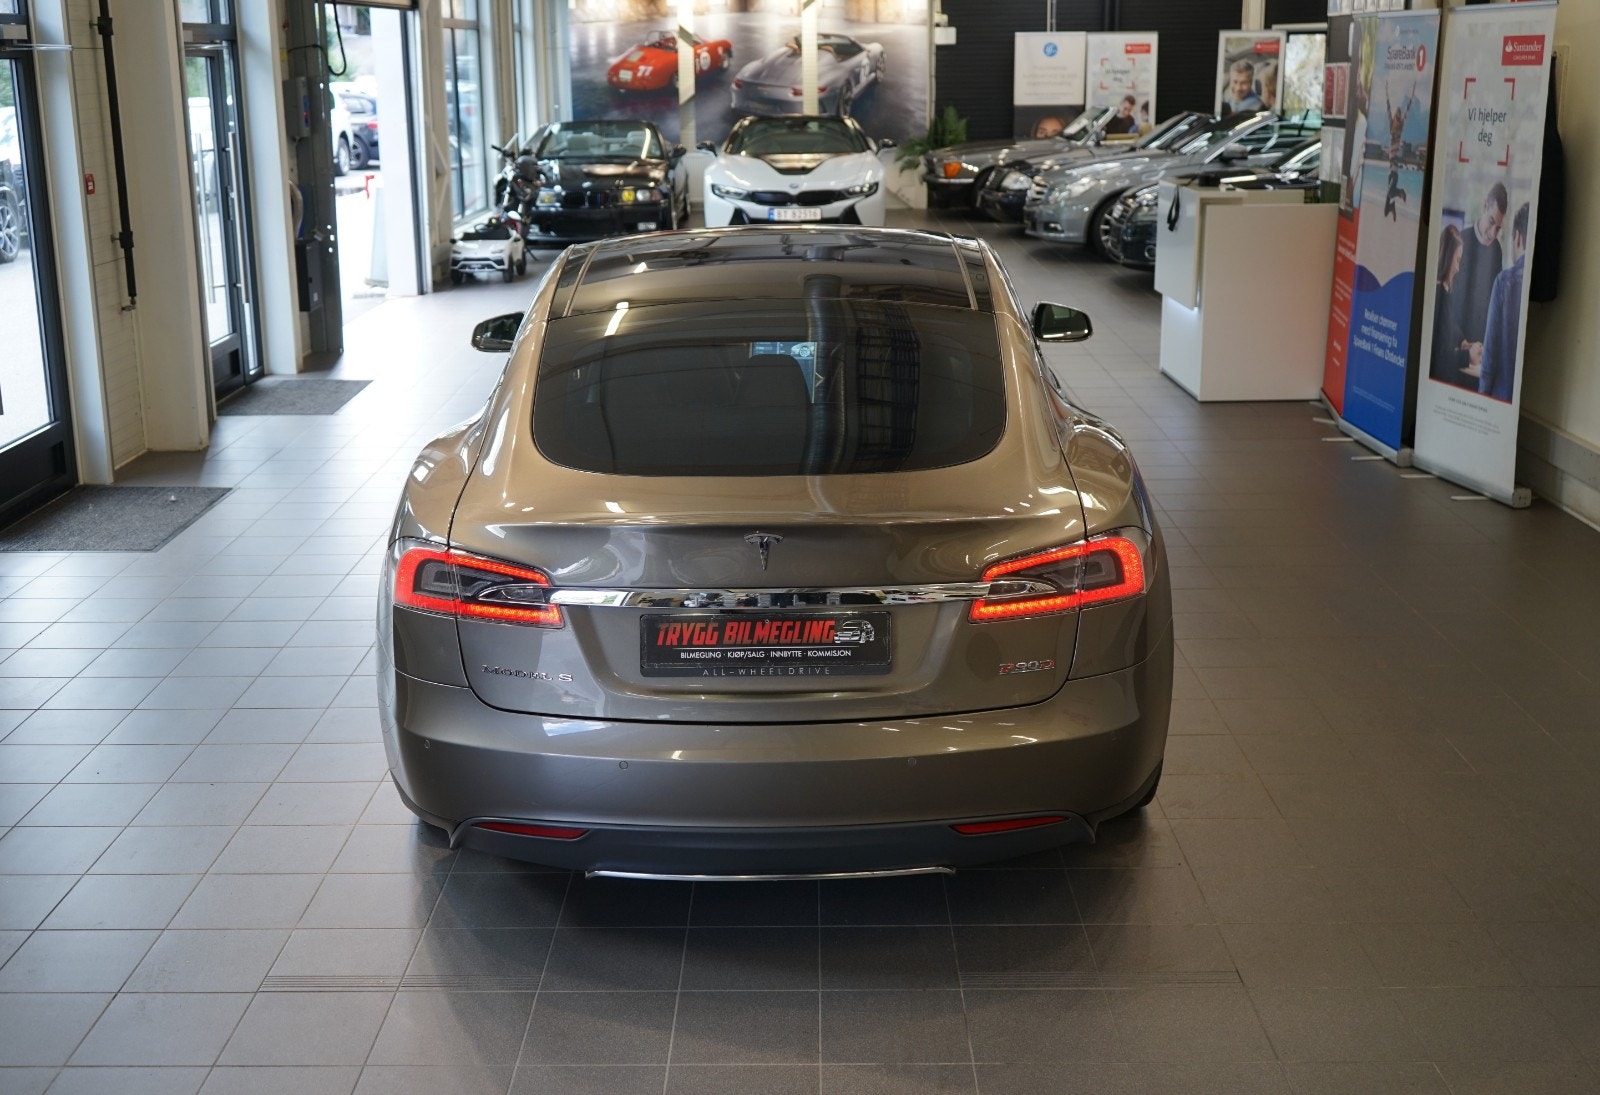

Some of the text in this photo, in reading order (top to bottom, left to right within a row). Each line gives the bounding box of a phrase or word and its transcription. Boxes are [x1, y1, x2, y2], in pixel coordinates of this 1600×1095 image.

[1387, 45, 1415, 61] SpareBank
[1513, 40, 1542, 52] Santander
[1468, 108, 1507, 125] Vi hjelper
[1478, 128, 1493, 147] deg
[657, 620, 836, 646] TRYGG BILMEGLING
[680, 649, 852, 660] BILMEGLING KJØP/SALG INNBYTTE KOMMISJON
[482, 664, 573, 682] MODEL S
[788, 666, 831, 676] DRIVE
